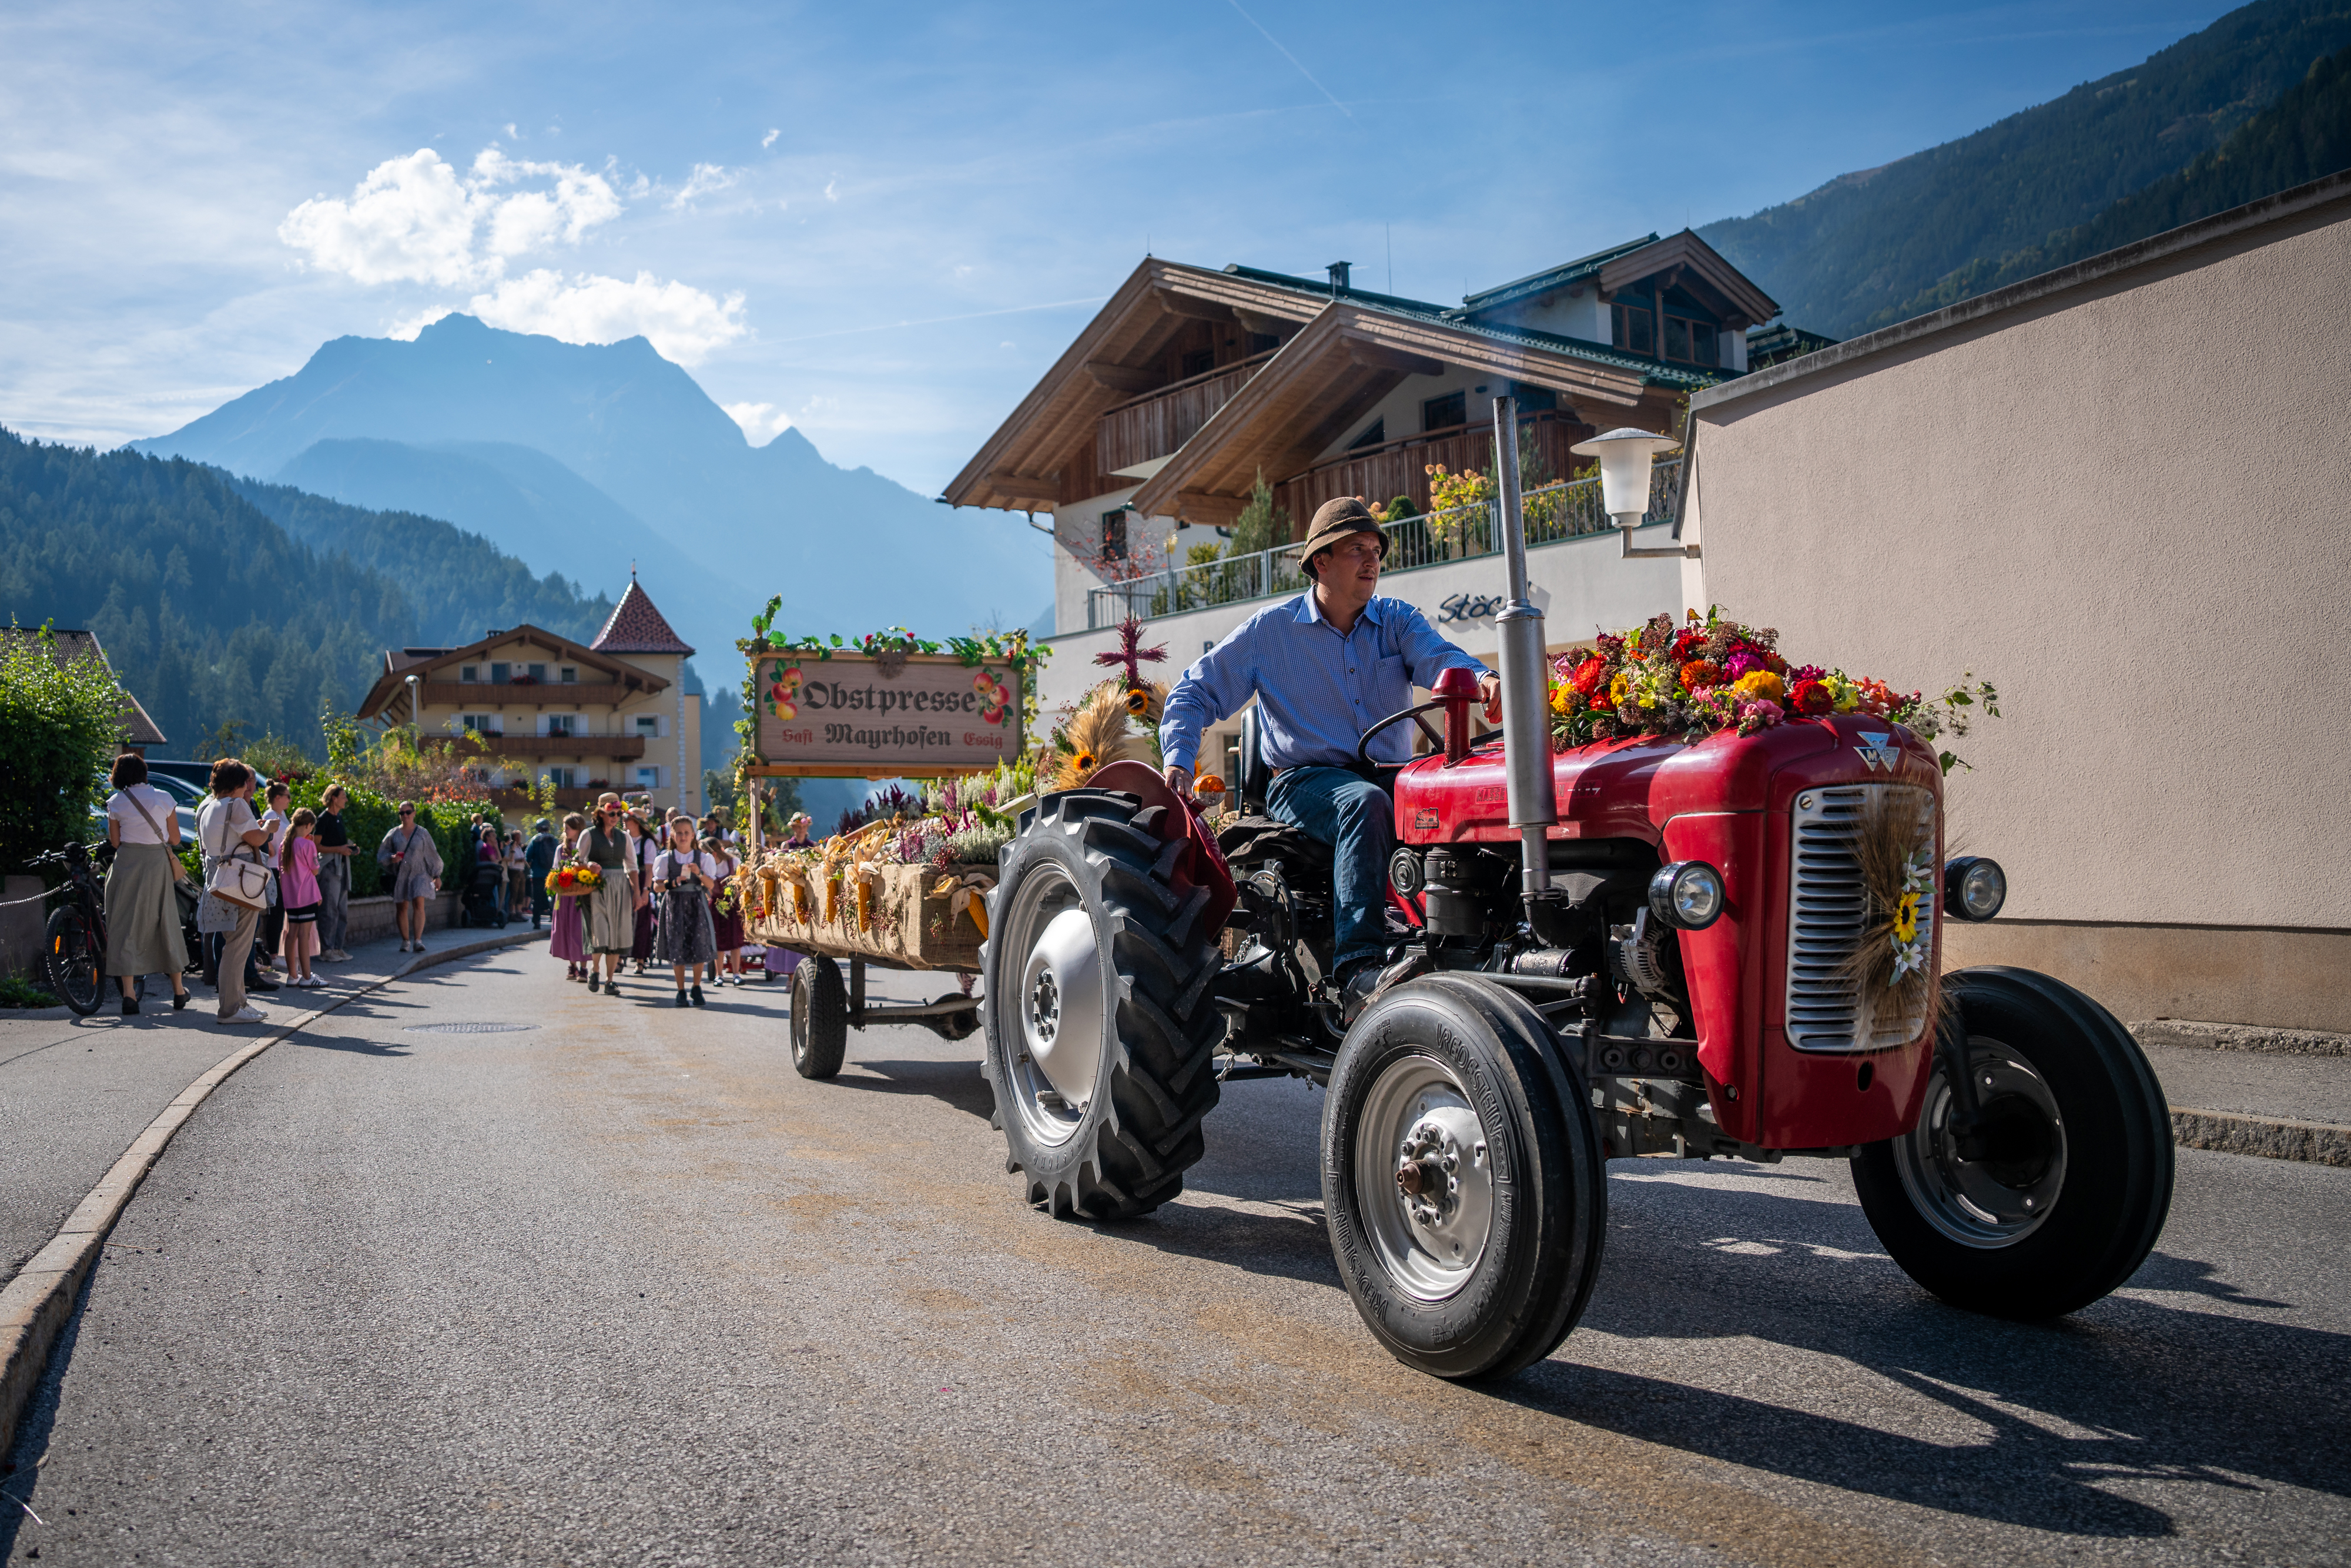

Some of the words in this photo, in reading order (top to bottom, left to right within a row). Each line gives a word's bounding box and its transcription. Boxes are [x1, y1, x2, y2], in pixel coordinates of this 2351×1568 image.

[802, 681, 976, 716] Obstpresse
[782, 728, 813, 746] Saft
[825, 723, 951, 749] Mayrhofen
[963, 732, 1003, 749] Essig
[1476, 788, 1508, 802] MASSE
[1436, 1021, 1502, 1137] VREDESTEIN
[1334, 1211, 1388, 1325] VREDESTEIN
